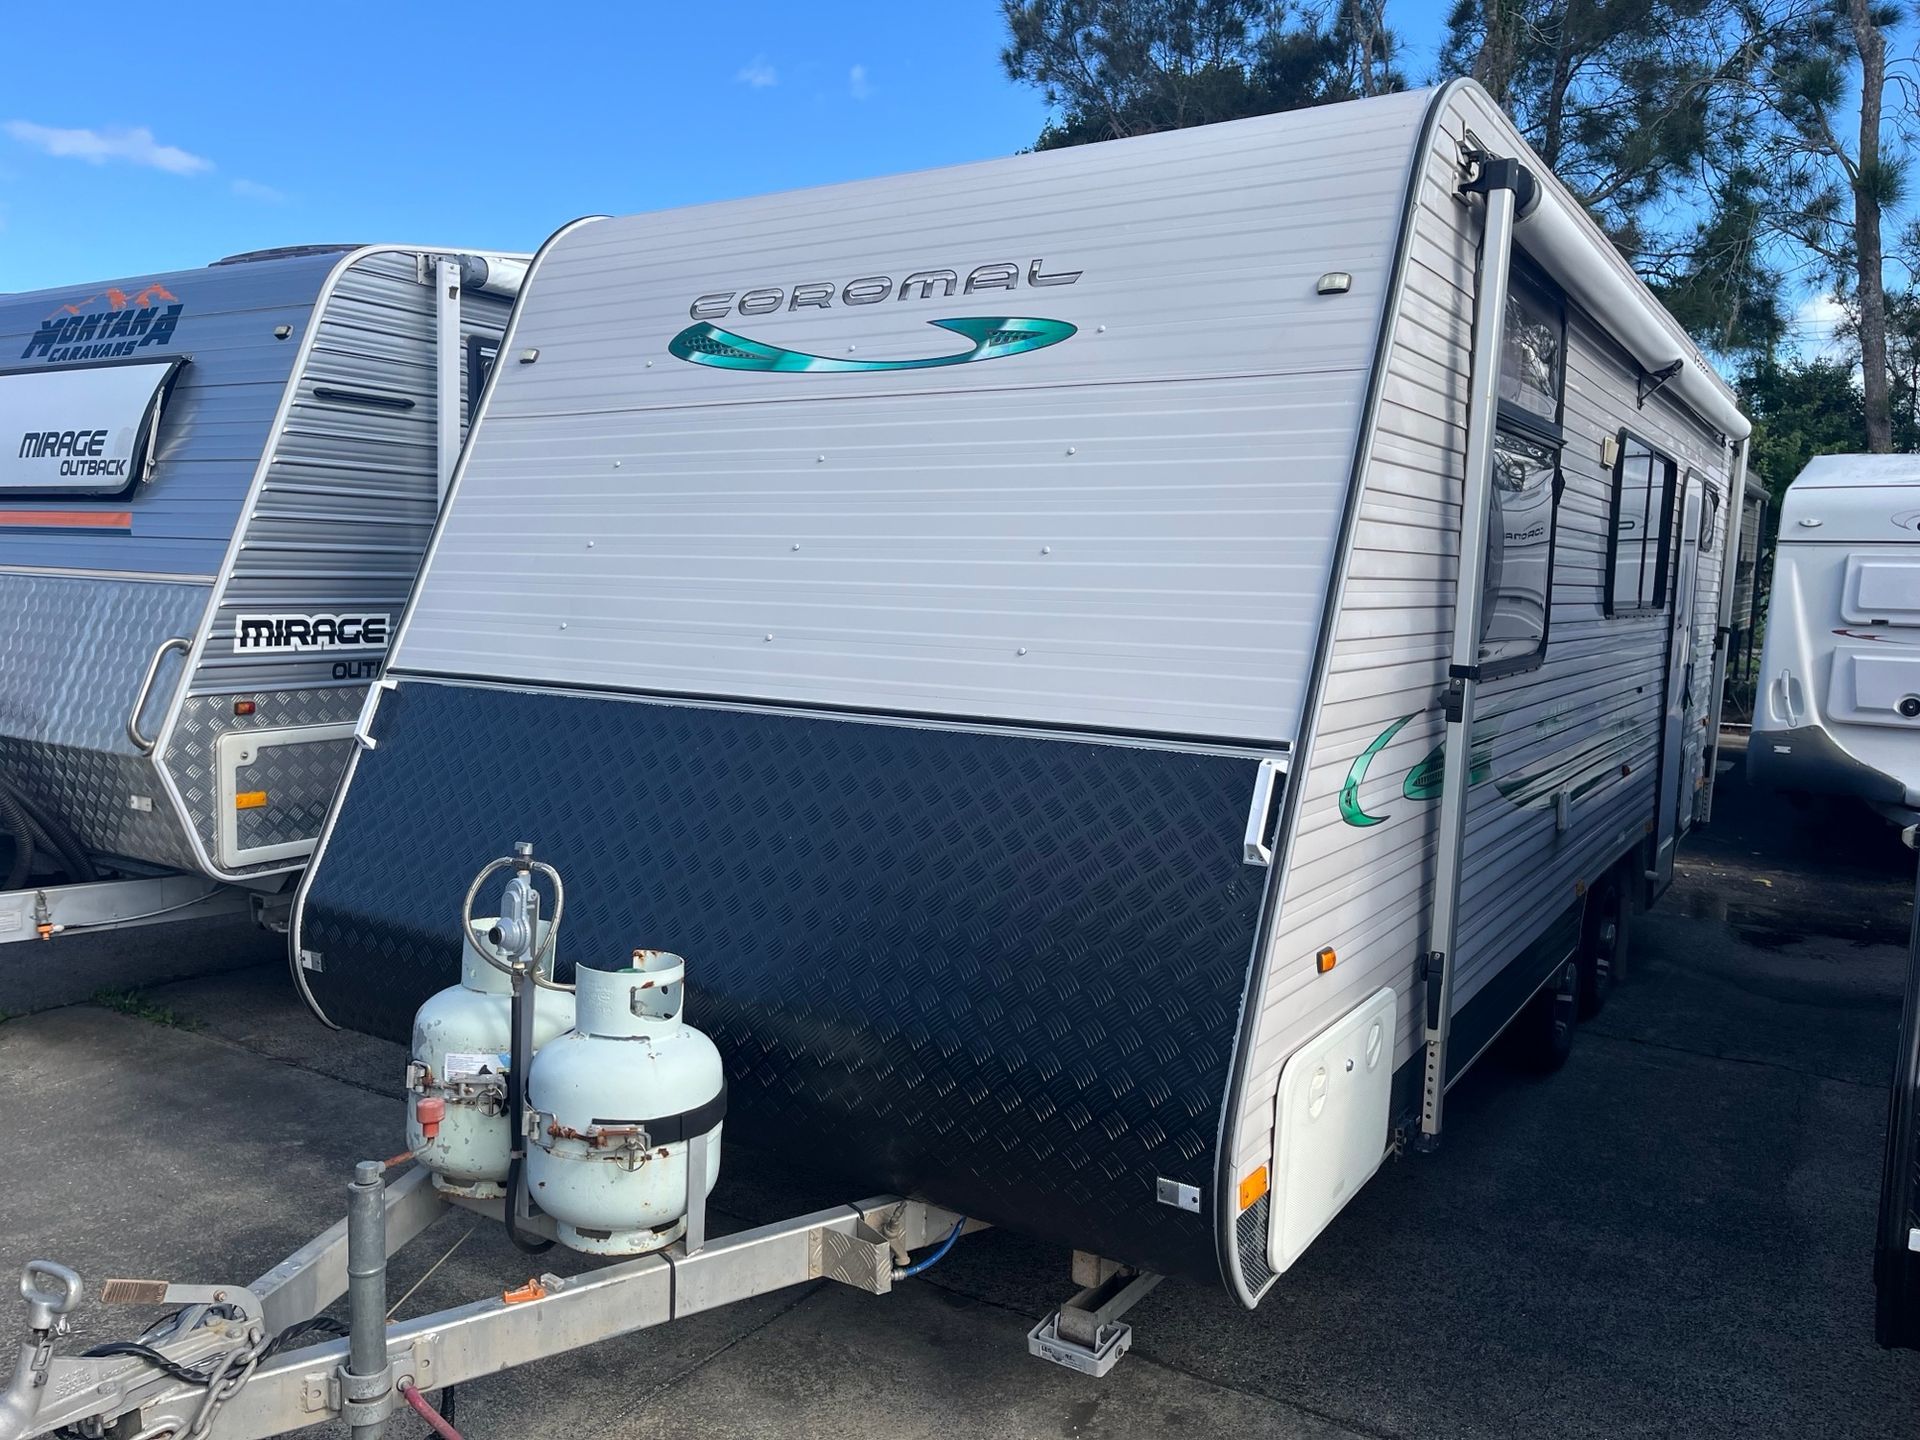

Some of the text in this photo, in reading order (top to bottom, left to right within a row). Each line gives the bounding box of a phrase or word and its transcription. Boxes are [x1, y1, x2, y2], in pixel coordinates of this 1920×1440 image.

[689, 258, 1084, 320] COROMAL
[20, 303, 184, 359] MONTANA
[47, 340, 139, 362] CARAVANS
[18, 429, 109, 459] MIRAGE
[59, 459, 127, 476] OUTBACK
[239, 618, 387, 648] MIRAGE
